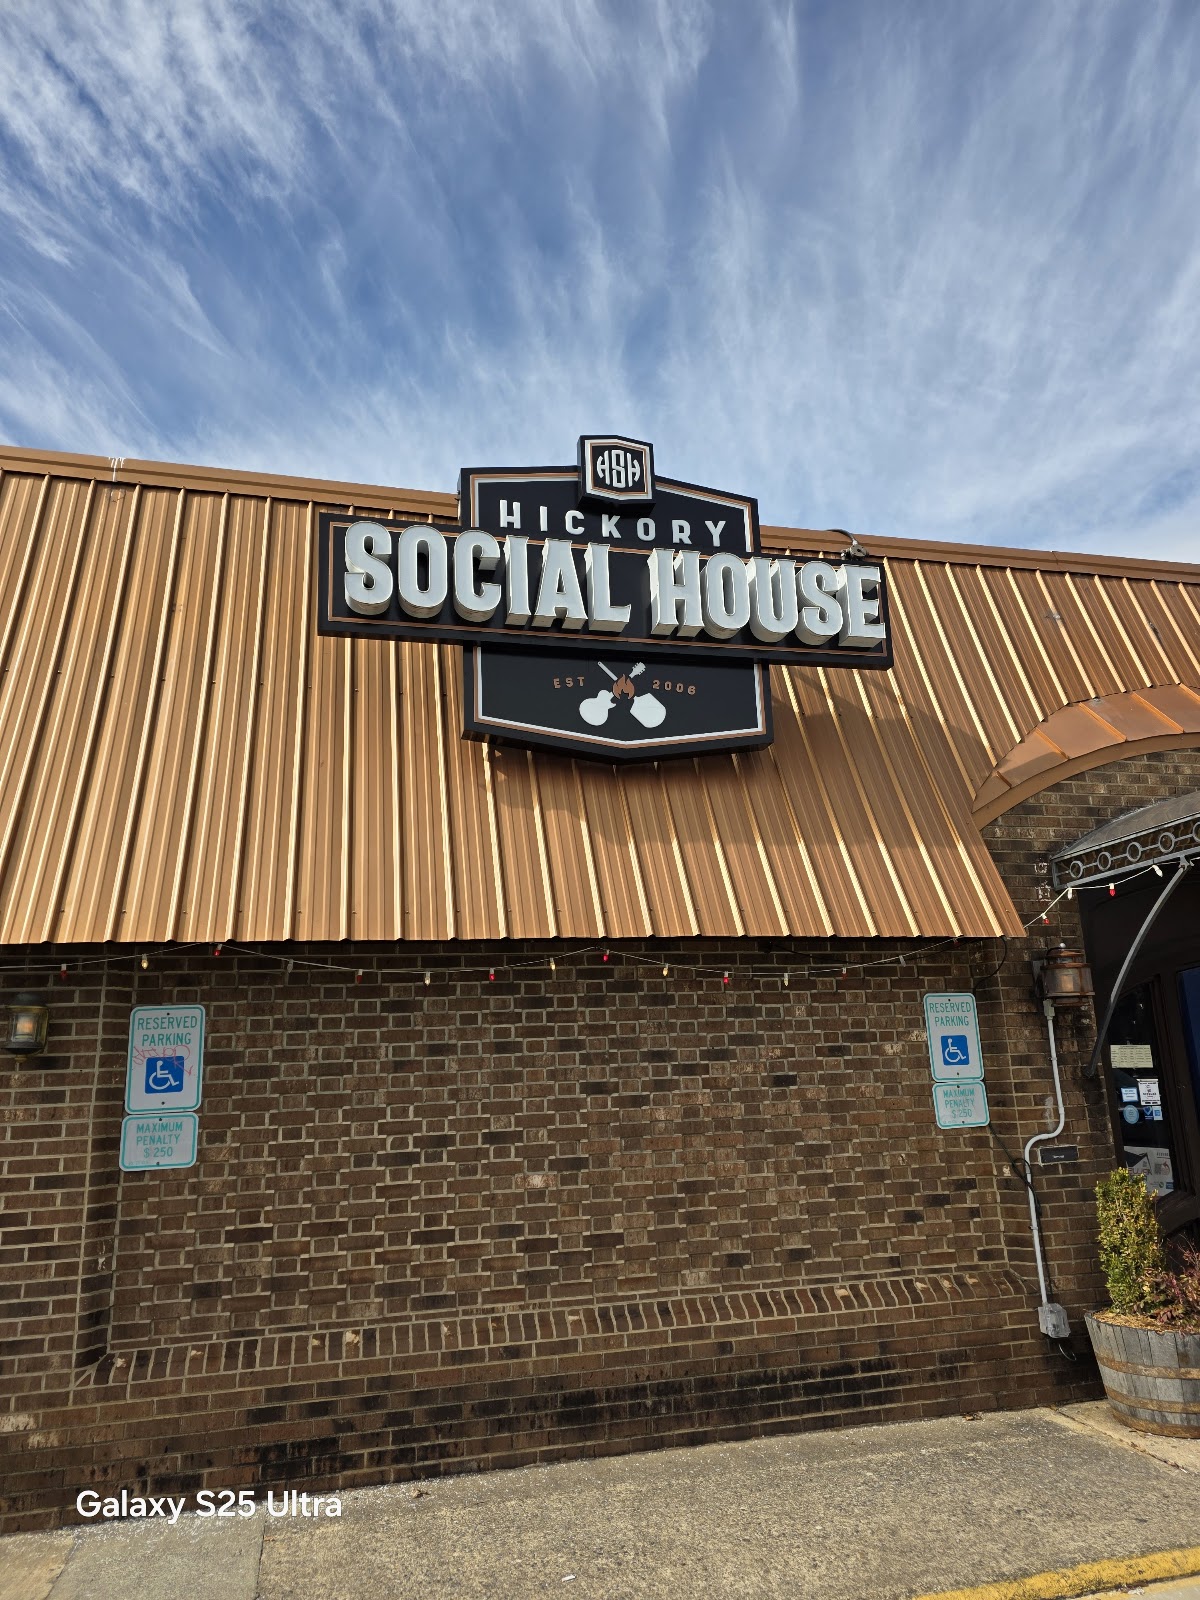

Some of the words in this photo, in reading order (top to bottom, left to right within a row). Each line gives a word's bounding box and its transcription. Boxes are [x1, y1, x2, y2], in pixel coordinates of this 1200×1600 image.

[596, 449, 641, 488] HSH
[499, 499, 727, 548] HICKORY
[344, 520, 632, 631] SOCIAL
[648, 547, 886, 647] HOUSE
[553, 676, 585, 689] EST
[652, 679, 696, 695] 2006
[929, 1002, 972, 1014] RESERVED
[137, 1015, 198, 1031] RESERVED
[934, 1015, 970, 1027] PARKING
[141, 1032, 192, 1047] PARKING
[943, 1087, 975, 1098] MAXIMUM
[945, 1098, 975, 1109] PENALTY
[136, 1121, 183, 1134] MAXIMUM
[136, 1133, 181, 1146] PENALTY
